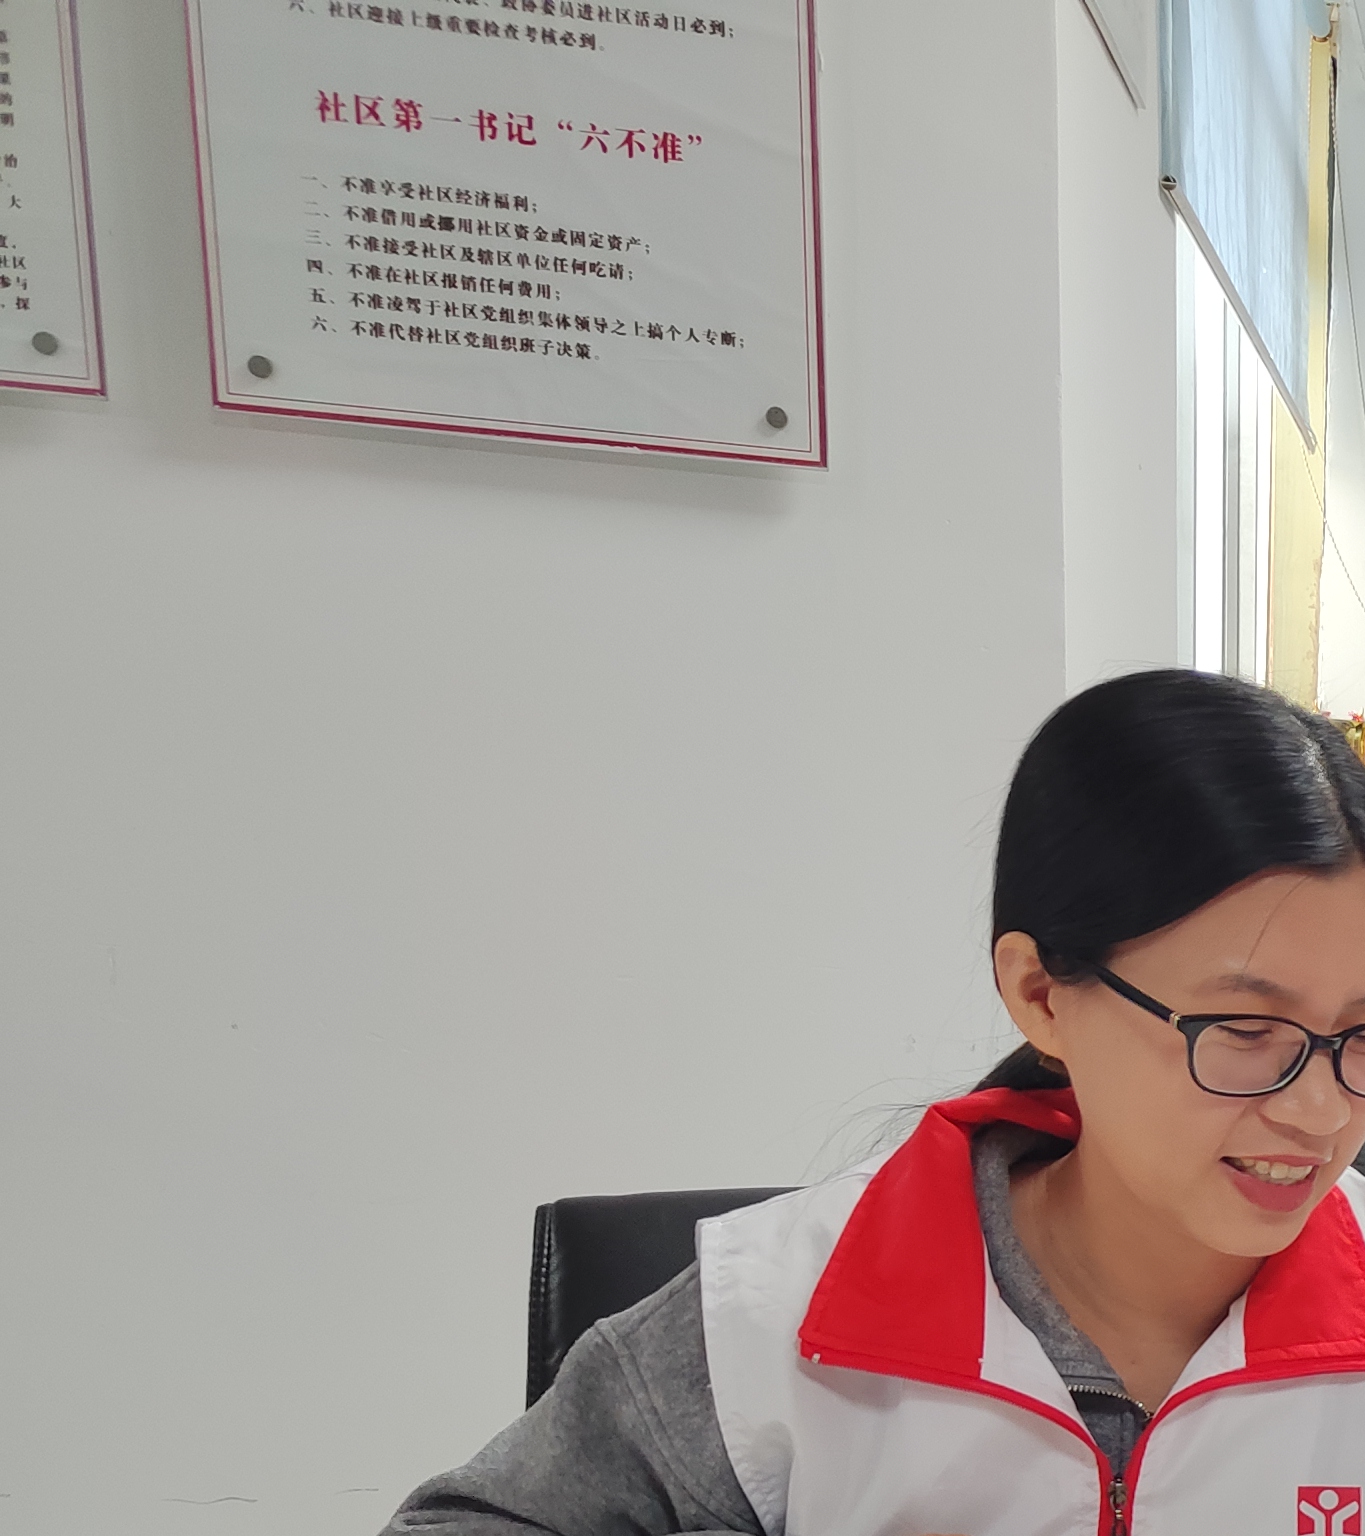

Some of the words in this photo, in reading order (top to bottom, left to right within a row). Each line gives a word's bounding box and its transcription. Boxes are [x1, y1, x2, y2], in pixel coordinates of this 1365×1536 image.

[315, 90, 704, 164] 社区第一书记“六不准”
[301, 174, 540, 214] 一、不准享受社区经济福利；
[306, 257, 562, 303] 四、不准在社区报销任何费用；
